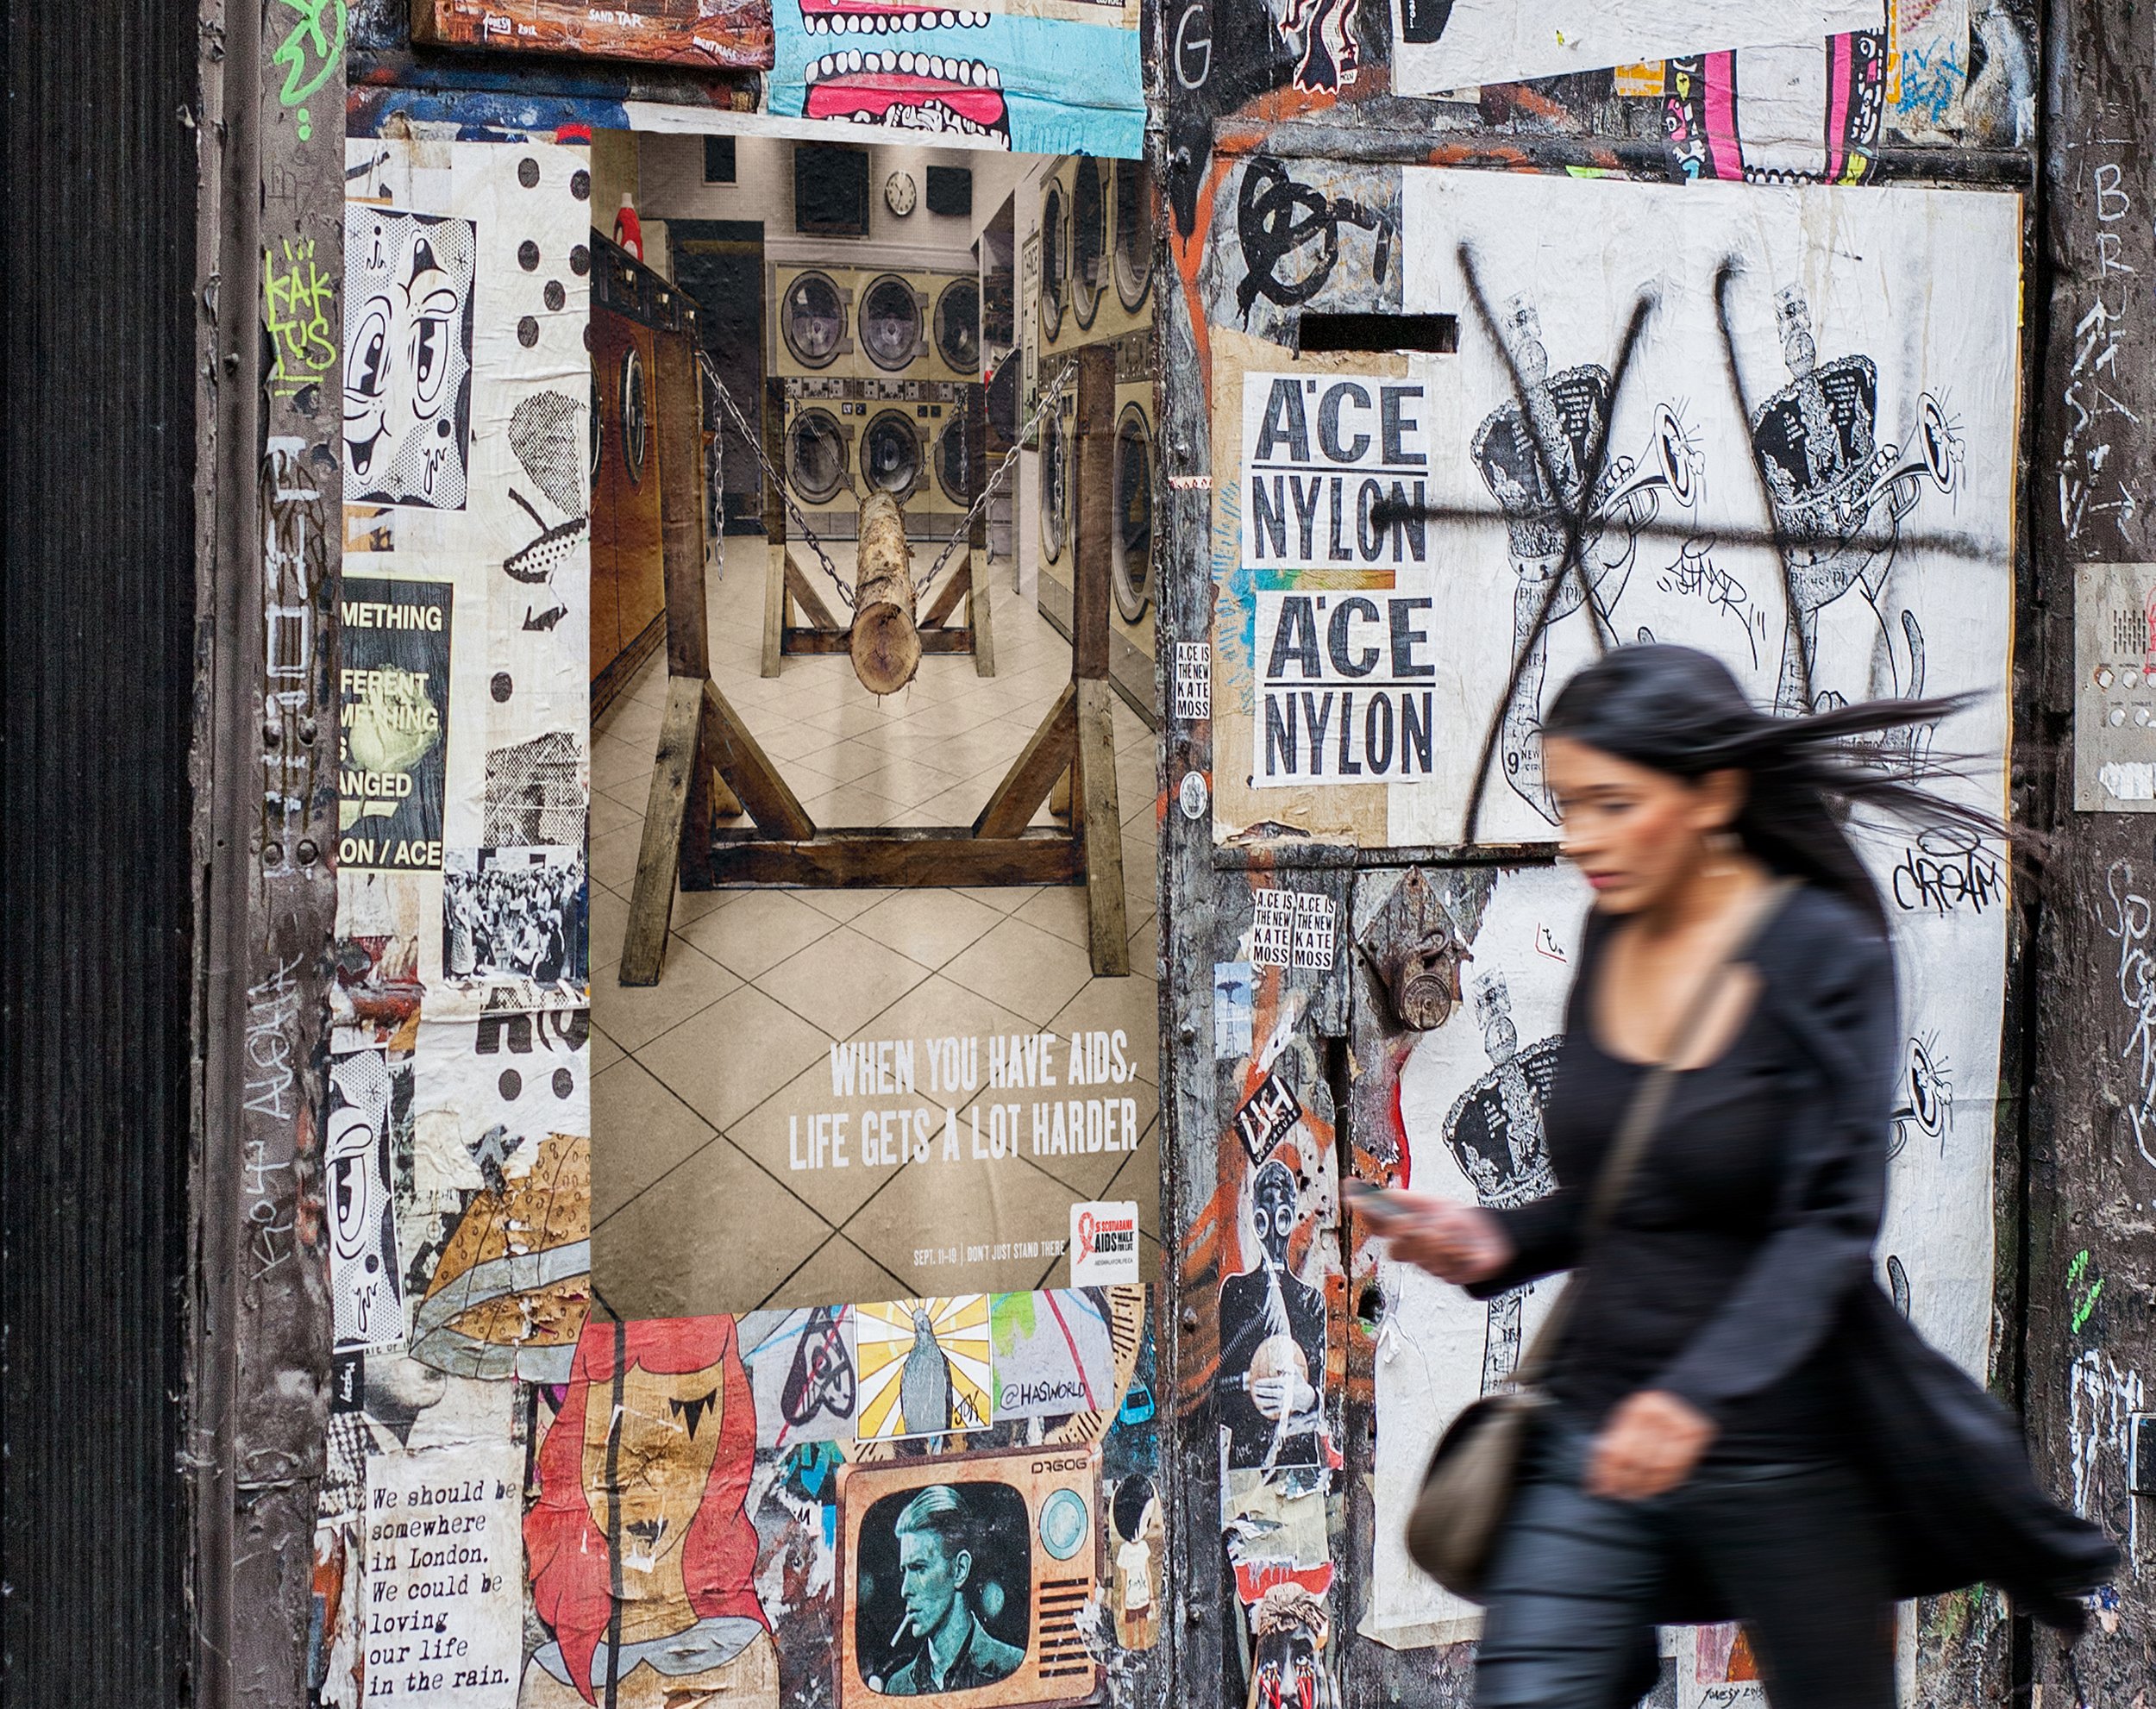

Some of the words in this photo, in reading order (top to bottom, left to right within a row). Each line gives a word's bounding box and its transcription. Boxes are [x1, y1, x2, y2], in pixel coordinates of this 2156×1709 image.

[588, 9, 614, 22] SAND
[617, 12, 643, 28] TAR
[1252, 475, 1426, 562] NYLON
[341, 601, 442, 632] METHING
[1201, 647, 1209, 662] IS
[1178, 663, 1192, 679] THE
[1194, 664, 1209, 679] NEW
[1177, 682, 1209, 698] KATE
[1177, 700, 1209, 717] MOSS
[1265, 691, 1432, 775] NYLON
[393, 840, 442, 867] ACE
[1283, 894, 1293, 910] IS
[1325, 898, 1335, 914] IS
[1257, 910, 1272, 925] THE
[1273, 911, 1292, 927] NEW
[1298, 914, 1313, 930] THE
[1314, 916, 1333, 931] NEW
[1254, 927, 1289, 946] KATE
[1295, 931, 1332, 949] KATE
[1253, 946, 1288, 964] MOSS
[1294, 949, 1332, 967] MOSS
[830, 1040, 914, 1098] WHEN
[925, 1036, 978, 1092] YOU
[989, 1033, 1057, 1090] HAVE
[1068, 1030, 1138, 1085] AIDS,
[789, 1112, 849, 1171] LIFE
[862, 1107, 931, 1168] GETS
[943, 1109, 961, 1161] A
[971, 1104, 1021, 1161] LOT
[1032, 1098, 1138, 1156] HARDER
[1101, 1218, 1134, 1232] SCOTIABANK
[913, 1249, 937, 1268] SEPT.
[967, 1244, 990, 1263] DON'T
[991, 1243, 1012, 1261] JUST
[1012, 1242, 1040, 1260] STAND
[1040, 1240, 1066, 1257] THERE
[1094, 1232, 1118, 1254] AIDS
[1118, 1231, 1134, 1243] WALK
[373, 1487, 398, 1511] We
[408, 1481, 485, 1506] should
[495, 1479, 517, 1500] be
[372, 1514, 486, 1540] somewhere
[372, 1551, 397, 1573] in
[408, 1544, 489, 1570] London.
[372, 1580, 398, 1604] We
[408, 1574, 469, 1599] could
[480, 1573, 504, 1595] be
[369, 1609, 449, 1637] loving
[369, 1645, 411, 1667] our
[419, 1637, 469, 1661] life
[368, 1675, 392, 1698] in
[406, 1669, 444, 1693] the
[452, 1664, 511, 1687] rain.
